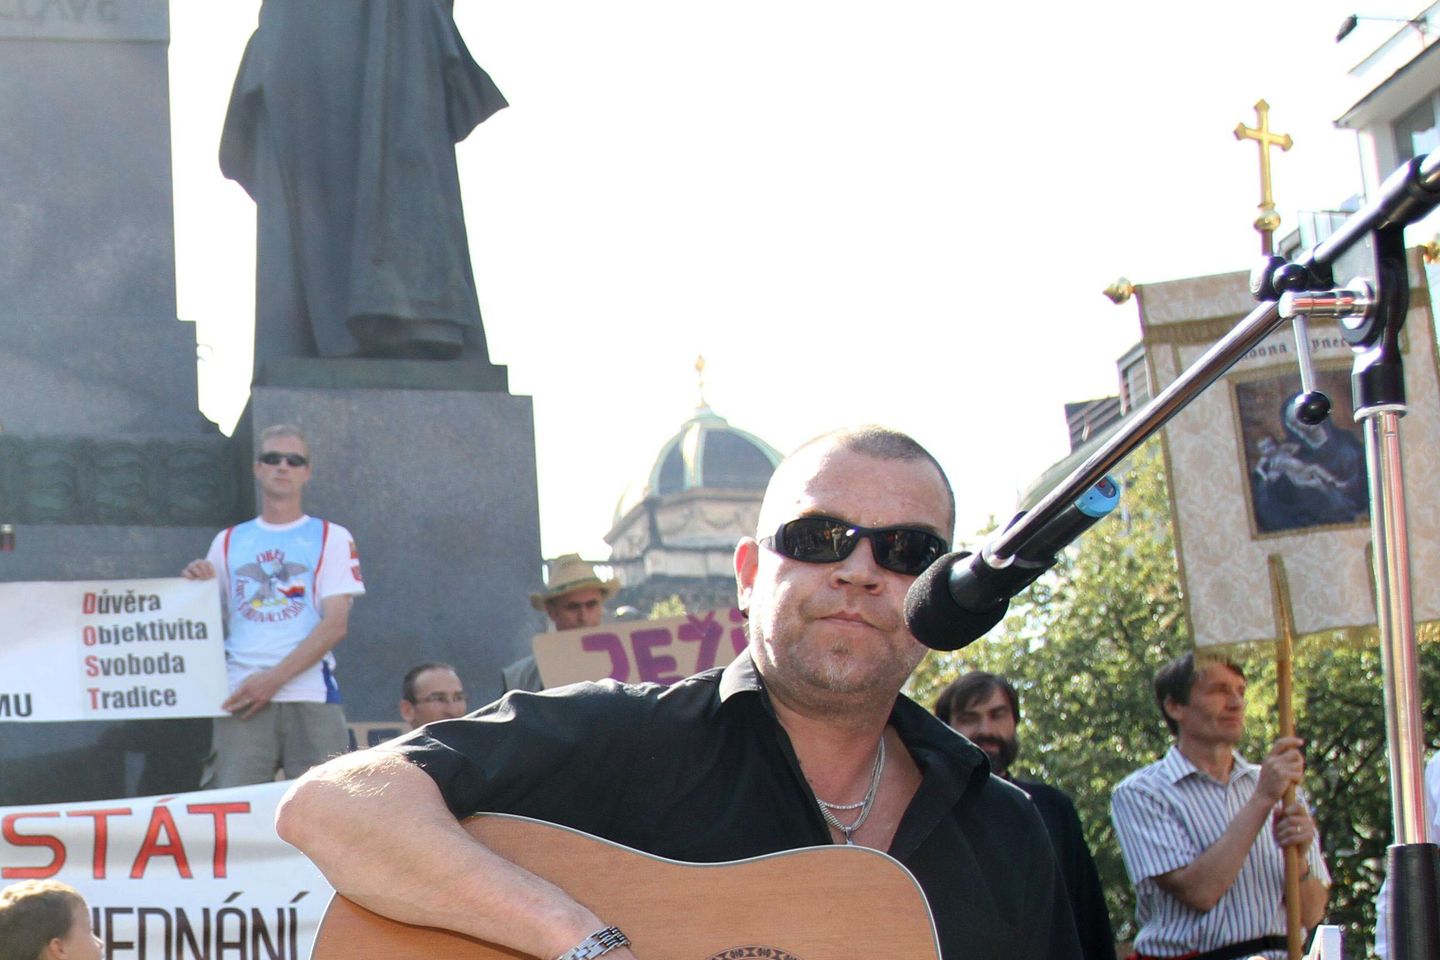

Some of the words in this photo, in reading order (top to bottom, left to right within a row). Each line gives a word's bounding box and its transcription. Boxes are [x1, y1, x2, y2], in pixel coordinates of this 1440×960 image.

[83, 618, 208, 646] Objektivita
[85, 652, 185, 677] Svoboda
[87, 686, 177, 710] Tradice
